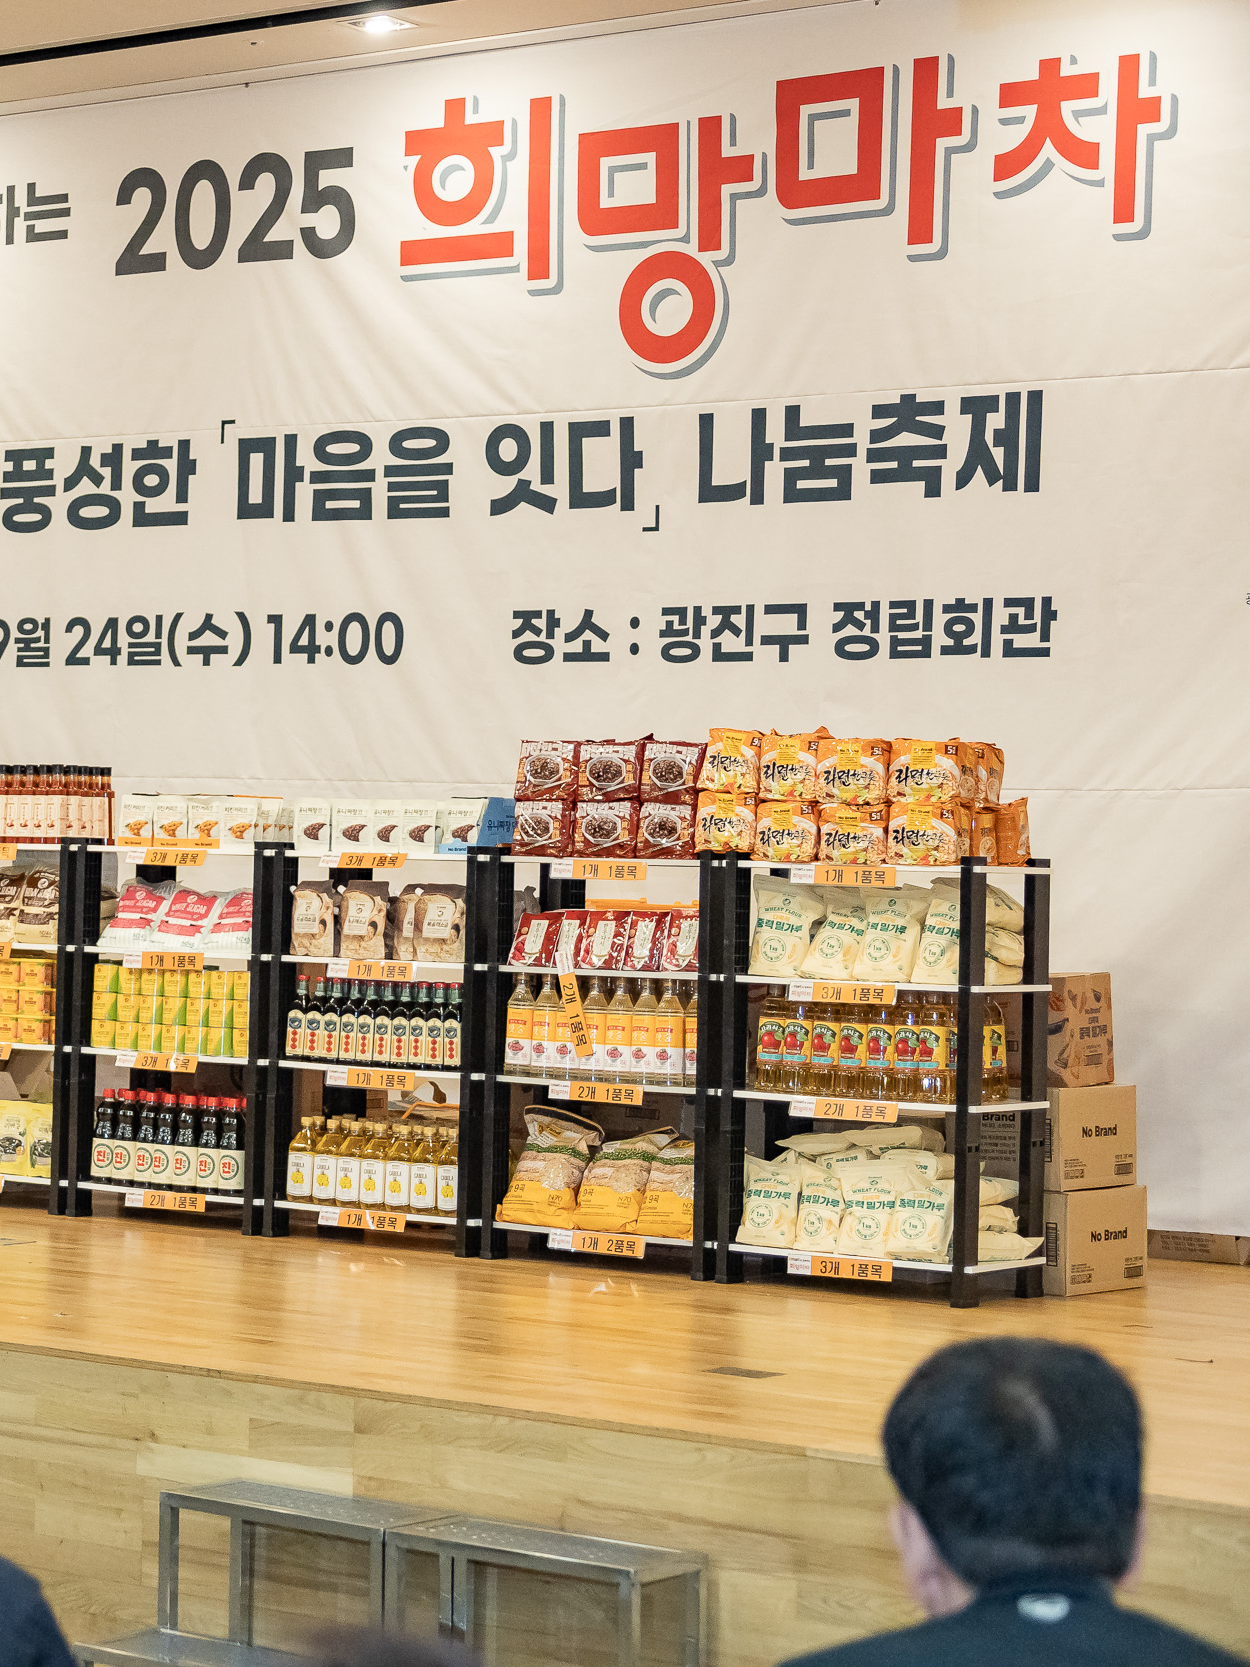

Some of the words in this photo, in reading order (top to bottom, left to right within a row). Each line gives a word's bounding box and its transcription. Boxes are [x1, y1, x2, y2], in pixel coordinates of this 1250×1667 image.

[114, 147, 356, 276] 2025
[400, 52, 1170, 372] 희망마차
[0, 437, 196, 533] 풍성한
[698, 390, 1043, 506] 나눔축제
[511, 608, 610, 665] 장소
[658, 602, 811, 664] 광진구
[832, 596, 1058, 662] 정립회관
[266, 611, 404, 666] 14:00
[151, 852, 166, 863] 3개
[174, 853, 199, 864] 1품목
[346, 856, 362, 866] 3개
[372, 857, 398, 867] 1품목
[582, 864, 598, 877] 1개
[609, 865, 637, 878] 1품목
[825, 870, 843, 883] 1개
[854, 870, 886, 884] 1품목
[150, 955, 164, 967] 1개
[172, 956, 196, 968] 1품목
[356, 965, 371, 976] 1개
[380, 966, 407, 978] 1품목
[562, 983, 577, 1005] 2개
[822, 986, 841, 1000] 3개
[852, 988, 883, 1002] 1품목
[569, 1014, 587, 1047] 1품목
[142, 1056, 158, 1067] 3개
[356, 1073, 371, 1085] 1개
[380, 1075, 406, 1087] 1품목
[578, 1087, 595, 1099] 2개
[606, 1088, 634, 1102] 1품목
[824, 1102, 844, 1116] 2개
[855, 1105, 887, 1119] 1품목
[982, 1112, 1015, 1121] Brand
[1082, 1126, 1092, 1138] No
[1095, 1124, 1117, 1137] Brand
[150, 1195, 165, 1206] 2개
[174, 1197, 197, 1209] 1품목
[548, 1194, 563, 1202] N70
[347, 1214, 362, 1226] 1개
[1091, 1231, 1102, 1242] No
[1104, 1227, 1127, 1241] Brand
[582, 1237, 598, 1250] 1개
[607, 1239, 636, 1253] 2품목
[820, 1261, 840, 1276] 3개
[850, 1263, 882, 1279] 1품목
